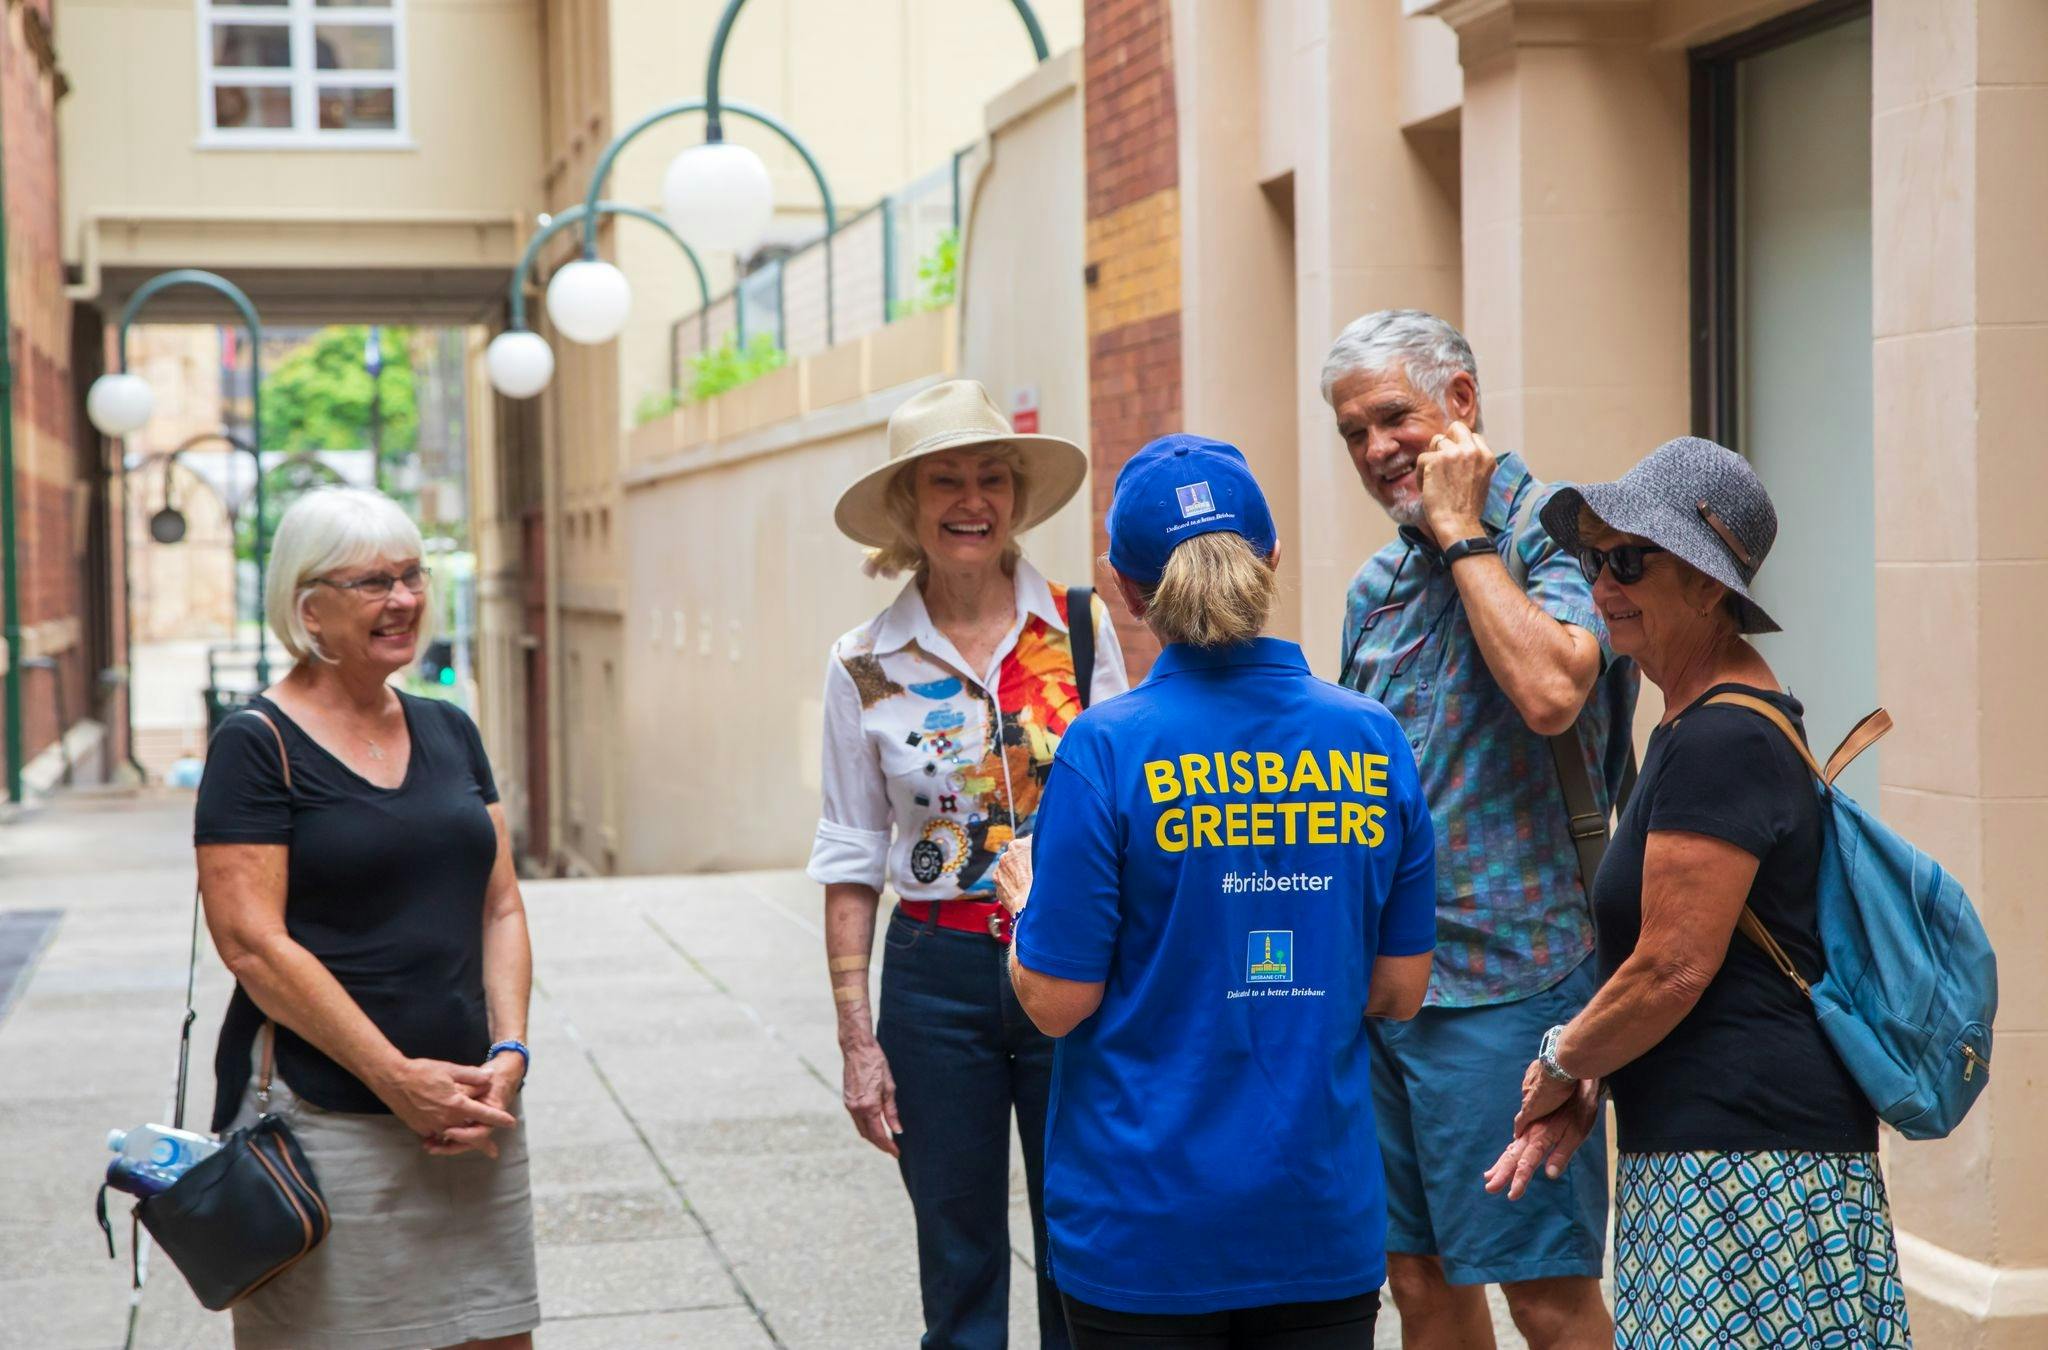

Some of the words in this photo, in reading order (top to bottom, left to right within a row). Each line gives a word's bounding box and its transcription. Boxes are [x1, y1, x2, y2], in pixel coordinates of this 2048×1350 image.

[1144, 750, 1389, 803] BRISBANE
[1155, 802, 1387, 852] GREETERS
[1221, 869, 1333, 893] #brisbetter
[1267, 988, 1289, 997] better
[1291, 987, 1326, 997] Brisbane
